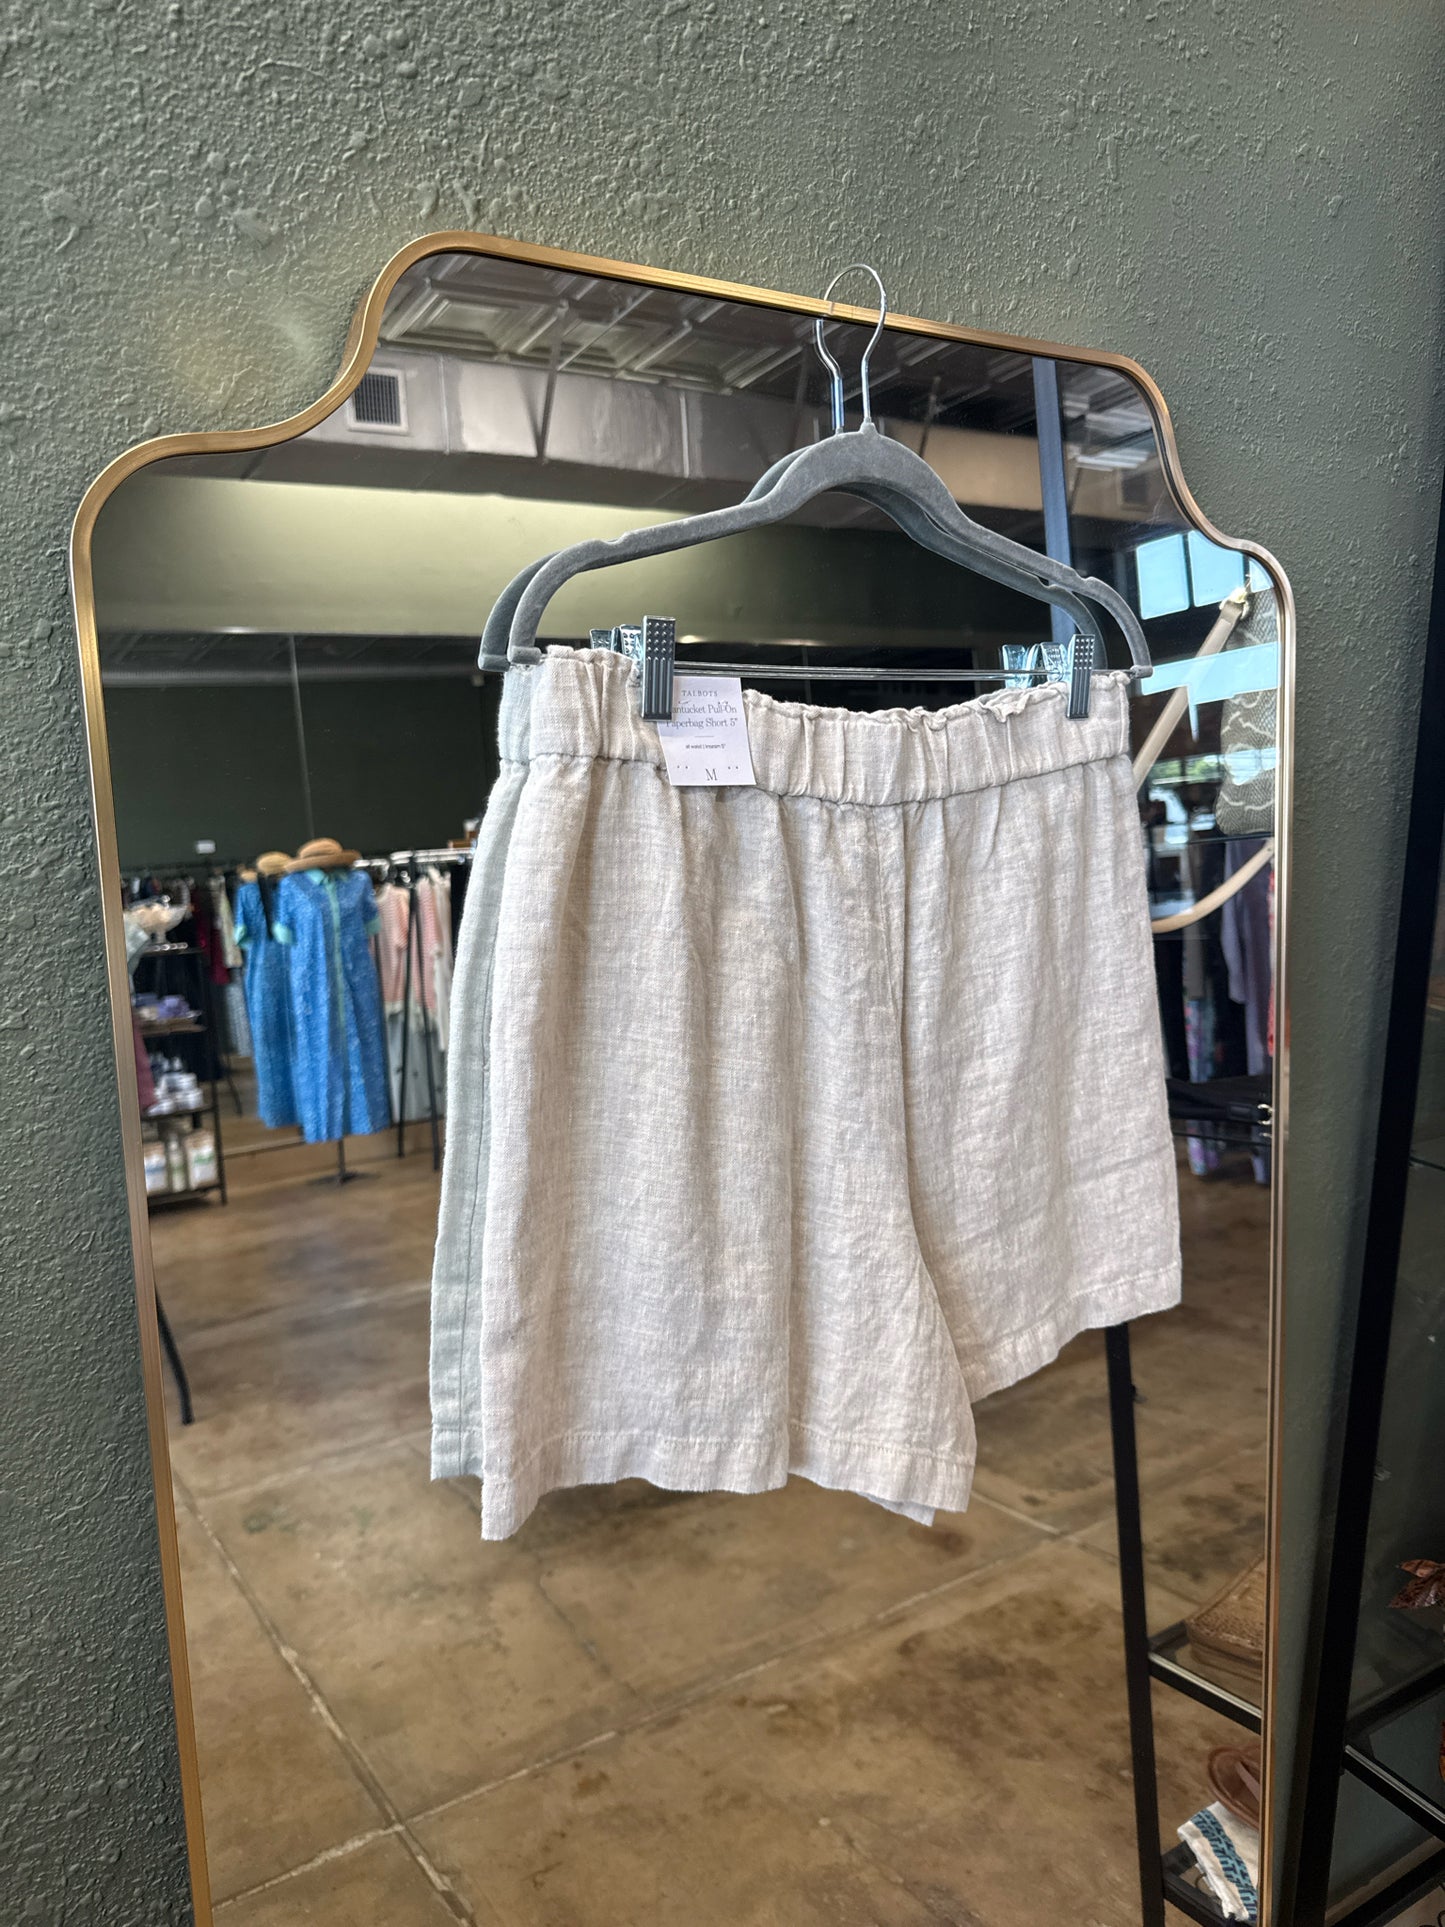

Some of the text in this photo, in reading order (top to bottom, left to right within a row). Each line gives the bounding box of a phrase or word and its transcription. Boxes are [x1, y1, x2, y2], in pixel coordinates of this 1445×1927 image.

[681, 690, 719, 698] TALBOTS
[671, 703, 705, 714] antucket
[706, 717, 728, 727] Short
[705, 767, 718, 781] M
